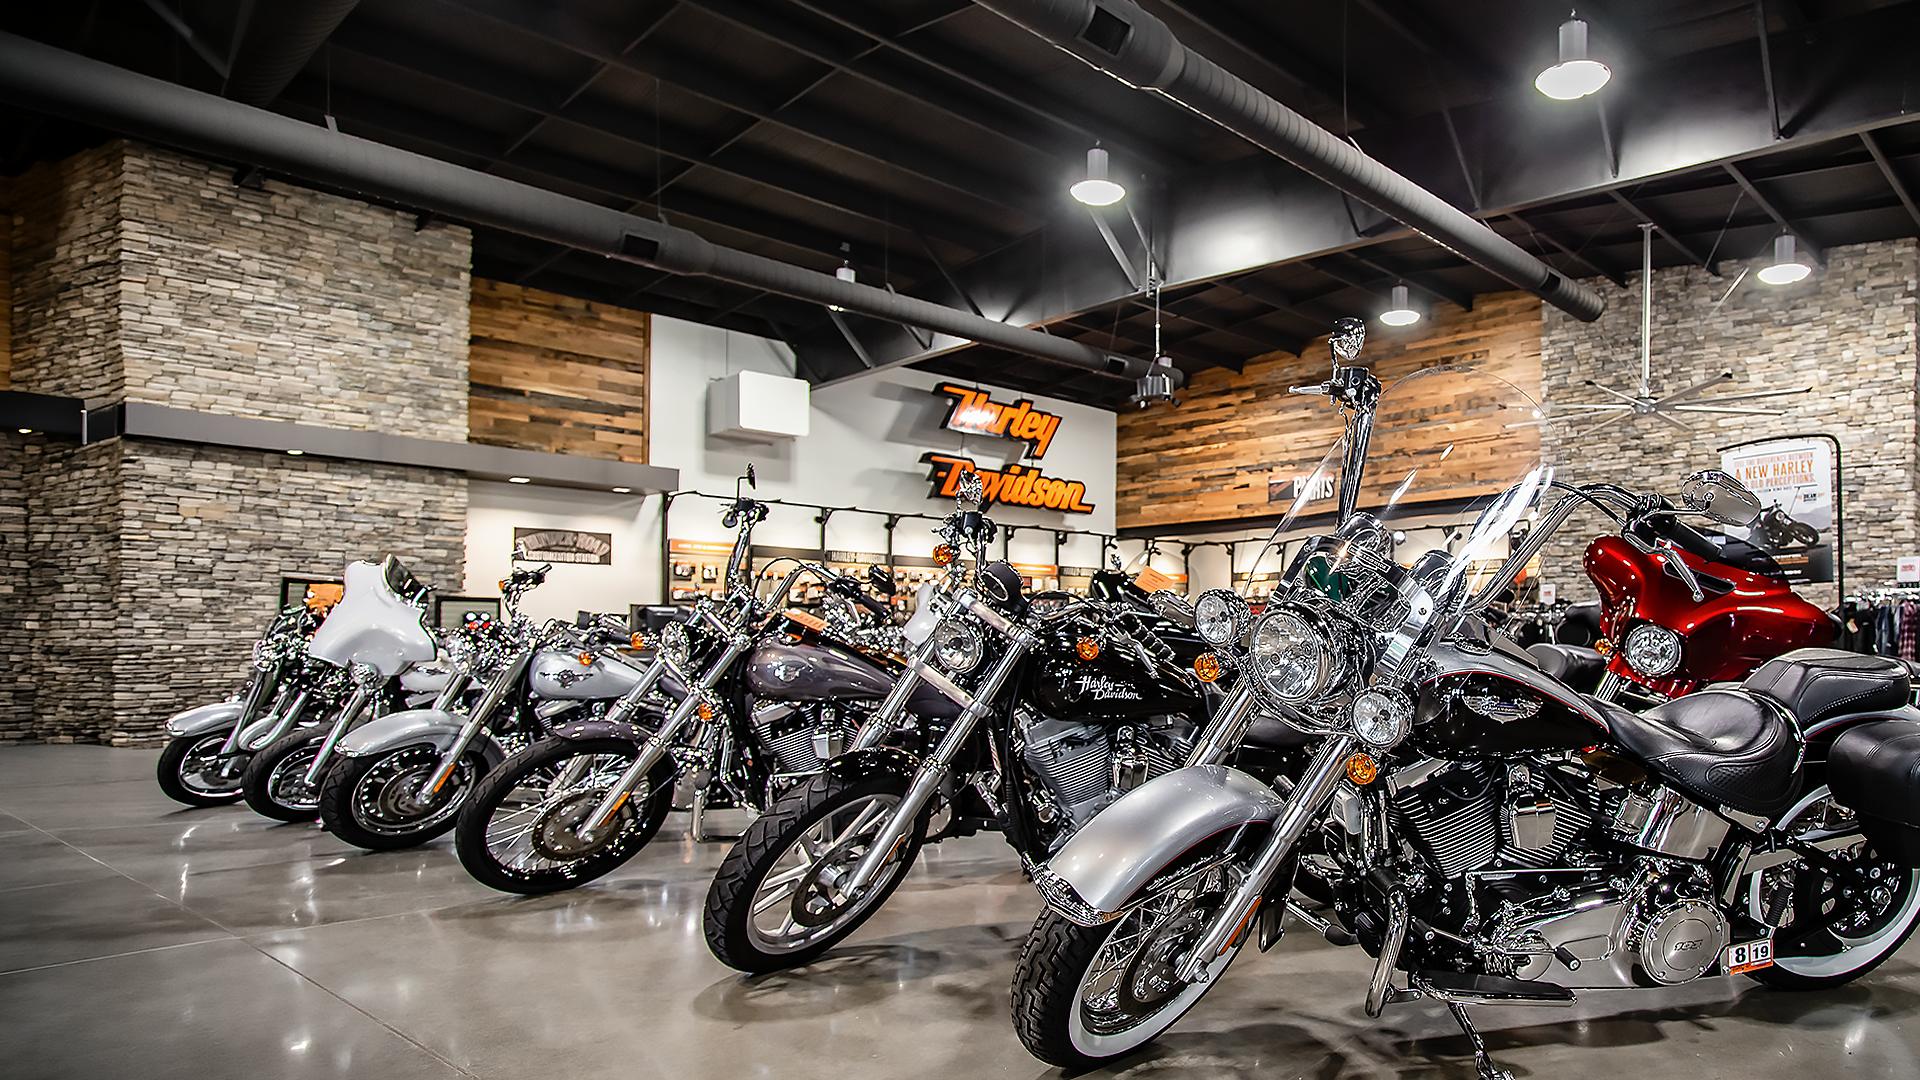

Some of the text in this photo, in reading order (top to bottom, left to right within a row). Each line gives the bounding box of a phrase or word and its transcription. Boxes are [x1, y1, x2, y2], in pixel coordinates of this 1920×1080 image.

[939, 384, 1061, 459] Harley
[1734, 467, 1742, 480] A
[1745, 464, 1769, 480] NEW
[1773, 459, 1814, 477] HARLEY
[1090, 687, 1143, 700] Davidson
[1735, 945, 1769, 964] 8 19
